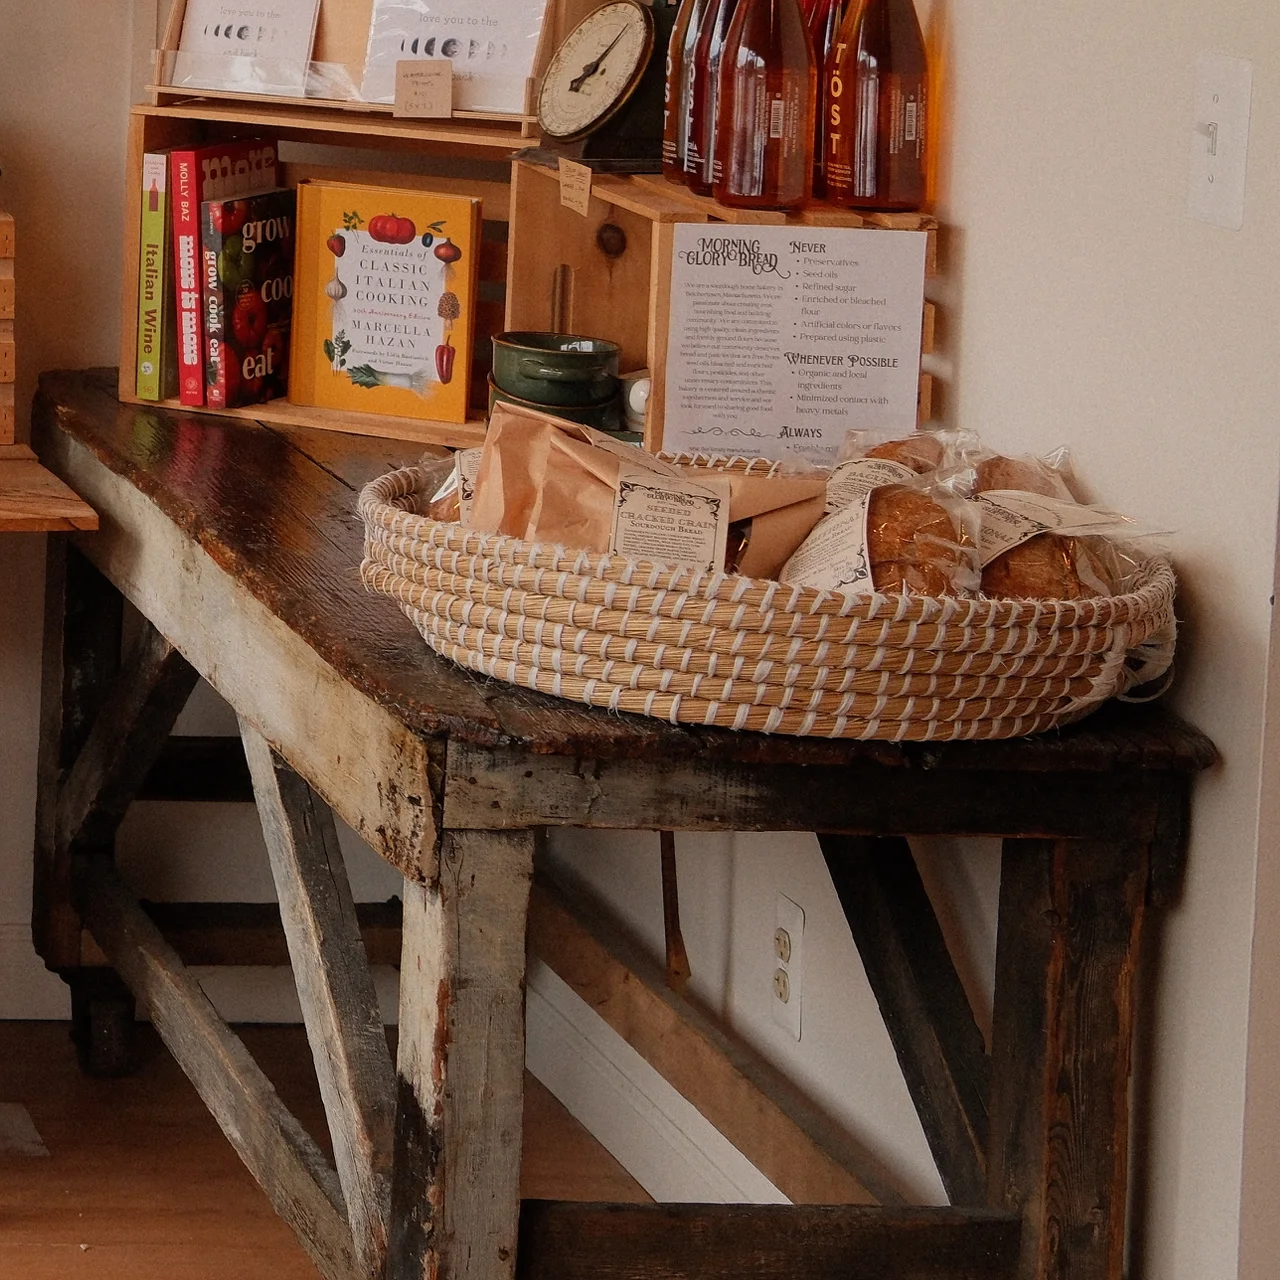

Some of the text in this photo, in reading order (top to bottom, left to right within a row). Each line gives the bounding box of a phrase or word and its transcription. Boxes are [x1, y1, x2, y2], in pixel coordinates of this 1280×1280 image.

[238, 9, 255, 19] you
[255, 10, 265, 18] to
[266, 9, 281, 19] the
[419, 14, 499, 27] love you to the
[830, 42, 847, 155] TÖST
[179, 162, 190, 222] MOLLY BAZ
[242, 216, 290, 254] grow
[361, 244, 429, 261] Essentials of
[697, 237, 760, 254] MORNING
[789, 240, 826, 254] NEVER
[359, 260, 427, 276] CLASSIC
[678, 250, 791, 279] GLORY BREAD
[803, 257, 859, 267] Preservatives
[802, 269, 838, 279] Seed oils
[261, 275, 294, 303] coo
[355, 275, 431, 292] ITALIAN
[802, 282, 857, 294] Refined sugar
[143, 243, 159, 355] Italian Wine
[355, 290, 428, 307] COOKING
[801, 294, 839, 304] Enriched
[850, 296, 887, 306] bleached
[204, 251, 222, 363] grow cook eat
[368, 308, 407, 320] Anniversary
[801, 307, 821, 316] flour
[351, 320, 432, 337] MARCELLA
[800, 320, 835, 329] Artificial
[836, 321, 861, 330] colors
[873, 322, 902, 332] flavors
[365, 335, 416, 348] HAZAN
[799, 332, 886, 344] Prepared using plastic
[242, 347, 276, 380] eat
[783, 351, 899, 368] WHENEVER POSSIBLE
[797, 368, 868, 379] Organic and local
[797, 381, 842, 391] ingredients
[796, 393, 889, 405] Minimized contact with
[795, 405, 849, 416] heavy metals
[777, 425, 822, 439] ALWAYS
[646, 505, 691, 517] SEEDED
[620, 511, 718, 530] CRACKED GRAIN
[630, 521, 703, 535] SOURDOUGH BREAD
